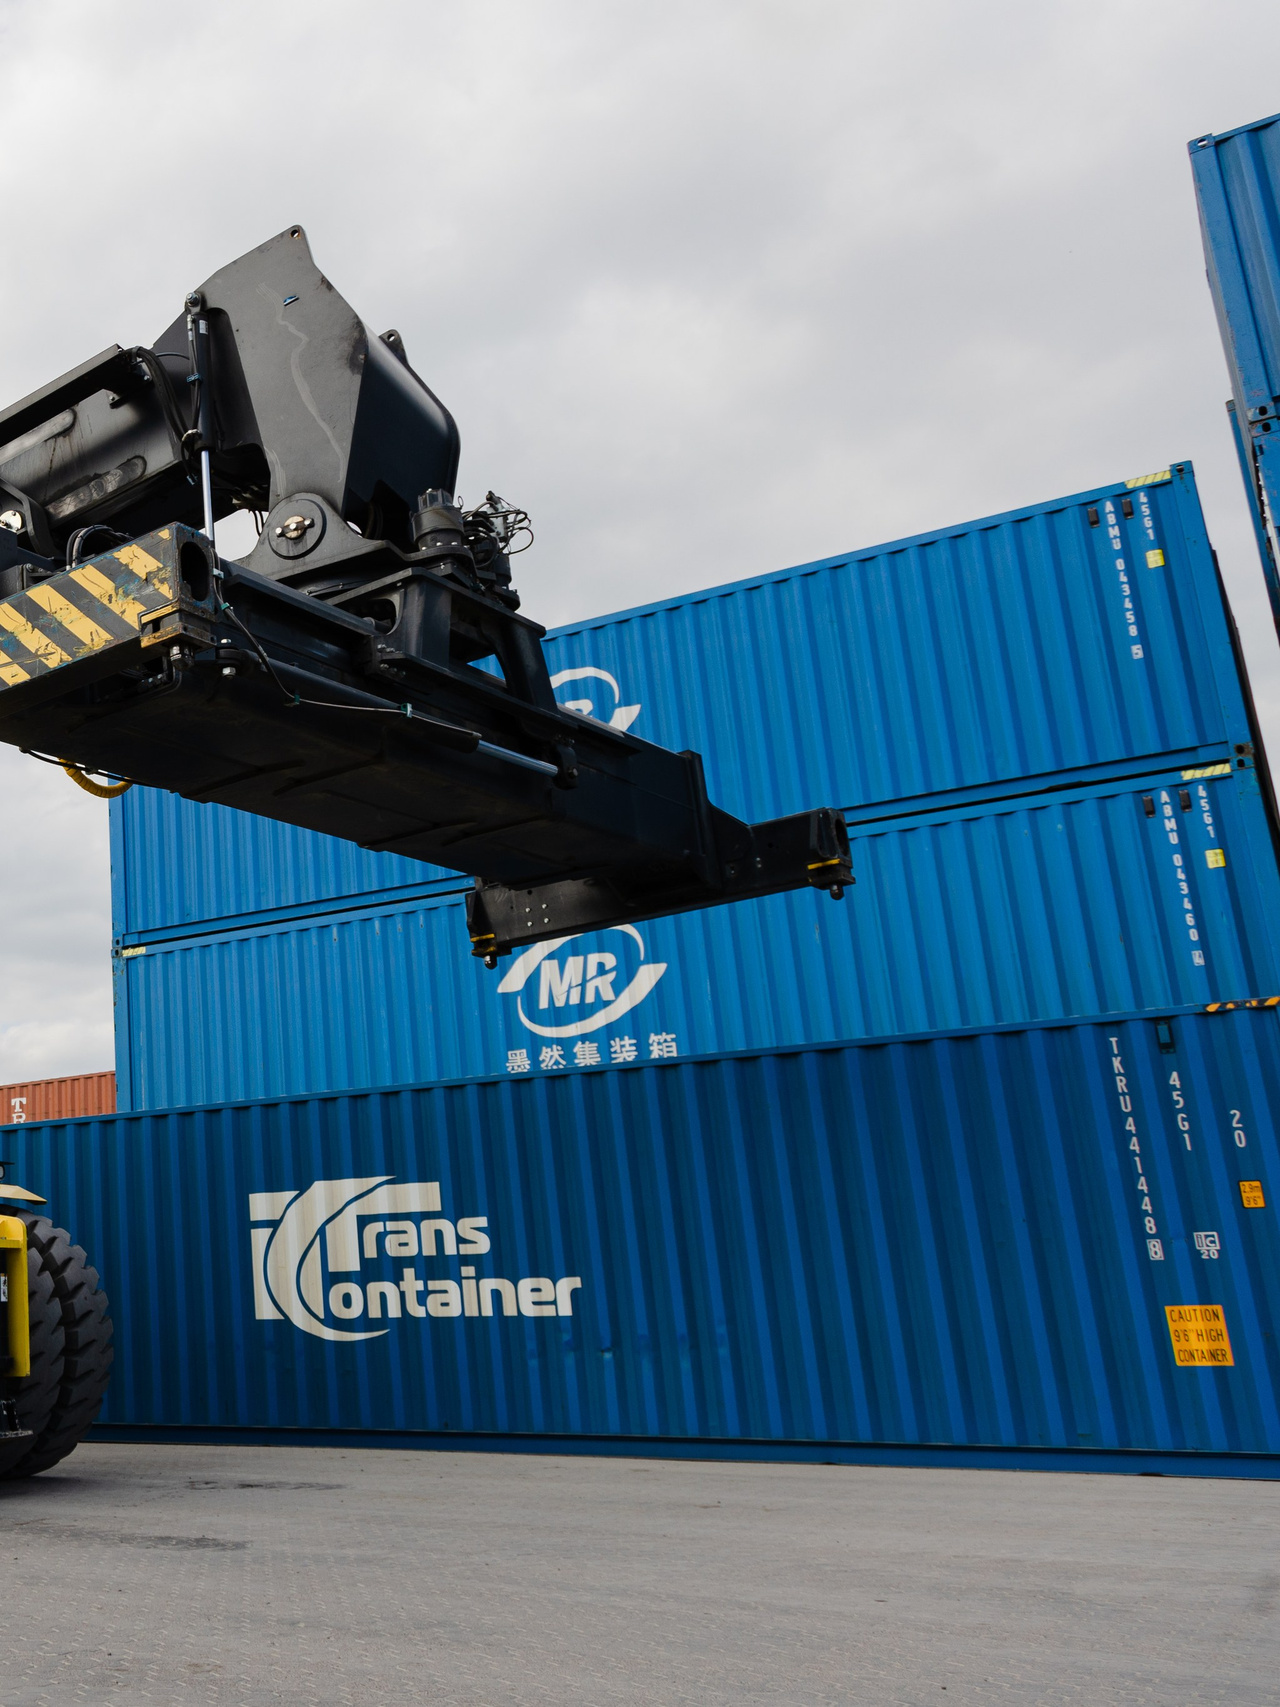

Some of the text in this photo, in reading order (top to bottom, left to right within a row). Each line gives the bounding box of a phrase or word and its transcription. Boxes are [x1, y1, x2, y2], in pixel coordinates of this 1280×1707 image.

[1105, 501, 1144, 660] ABMU 043458 5
[1161, 790, 1178, 844] ABMU
[1172, 854, 1199, 941] 043460
[539, 953, 619, 1010] MR
[1170, 1071, 1191, 1150] 45G1
[1230, 1109, 1246, 1148] 20
[325, 1178, 491, 1272] Trans
[1201, 1249, 1219, 1259] 20
[1169, 1308, 1221, 1323] CAUTION
[1196, 1328, 1225, 1342] HIGH
[1178, 1348, 1229, 1362] CONTAINER
